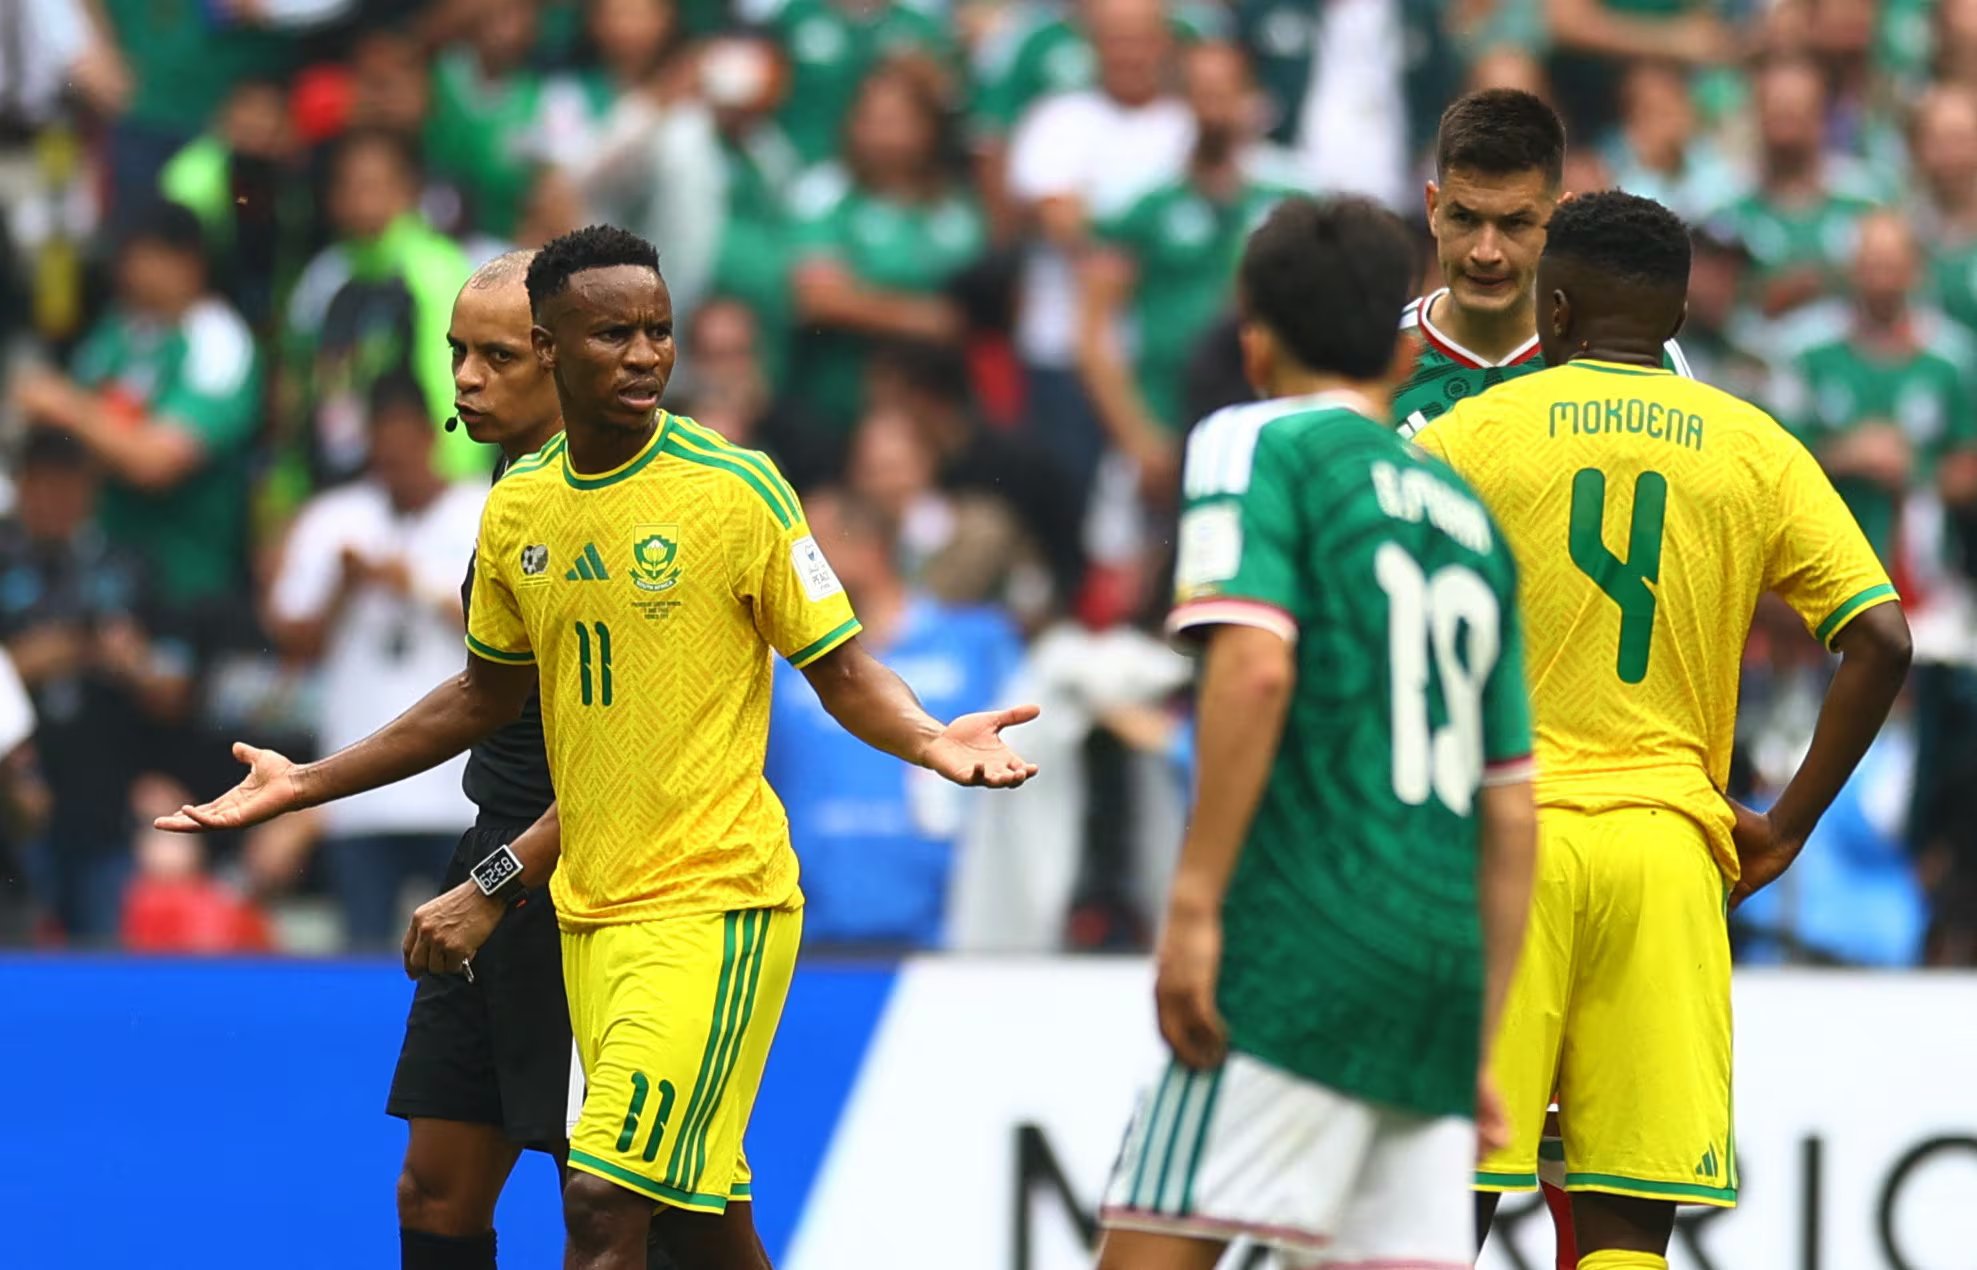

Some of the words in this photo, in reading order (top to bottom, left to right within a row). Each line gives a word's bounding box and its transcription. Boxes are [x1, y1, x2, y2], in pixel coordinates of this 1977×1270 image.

[1549, 398, 1703, 451] MOKOENA
[1567, 468, 1667, 684] 4
[575, 621, 612, 706] 11
[1373, 540, 1500, 817] 19
[479, 856, 514, 889] 83:29
[615, 1070, 676, 1162] 11
